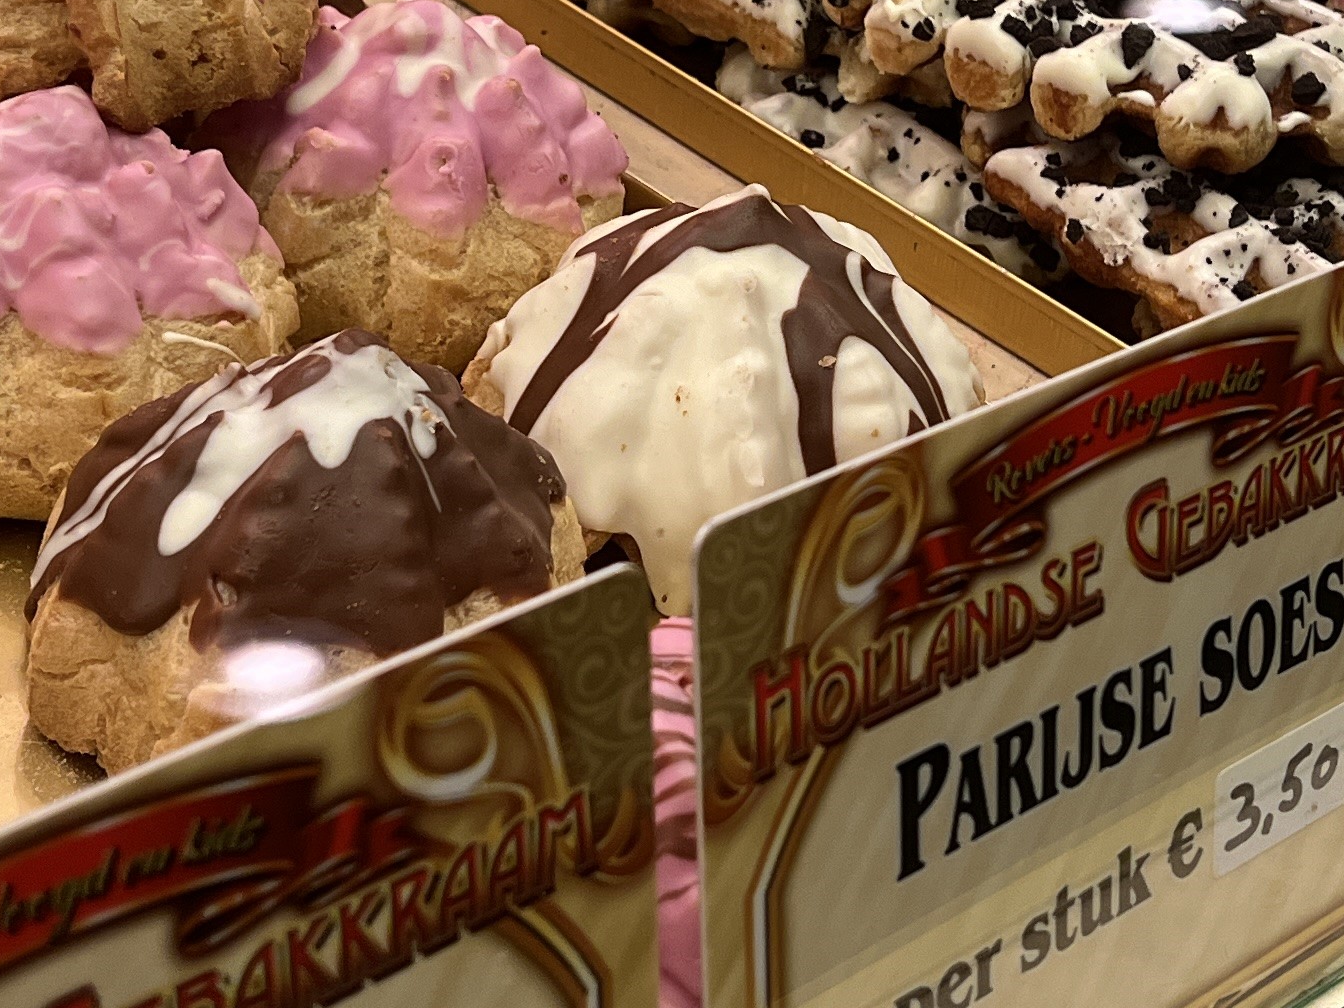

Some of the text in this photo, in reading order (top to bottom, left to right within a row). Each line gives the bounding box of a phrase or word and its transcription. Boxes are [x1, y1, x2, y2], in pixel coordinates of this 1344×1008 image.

[751, 540, 1105, 782] HOLLANDSE
[895, 646, 1177, 883] PARIJSE
[1020, 846, 1154, 974] stuk
[1167, 807, 1204, 880] €
[1224, 742, 1341, 854] 3,50
